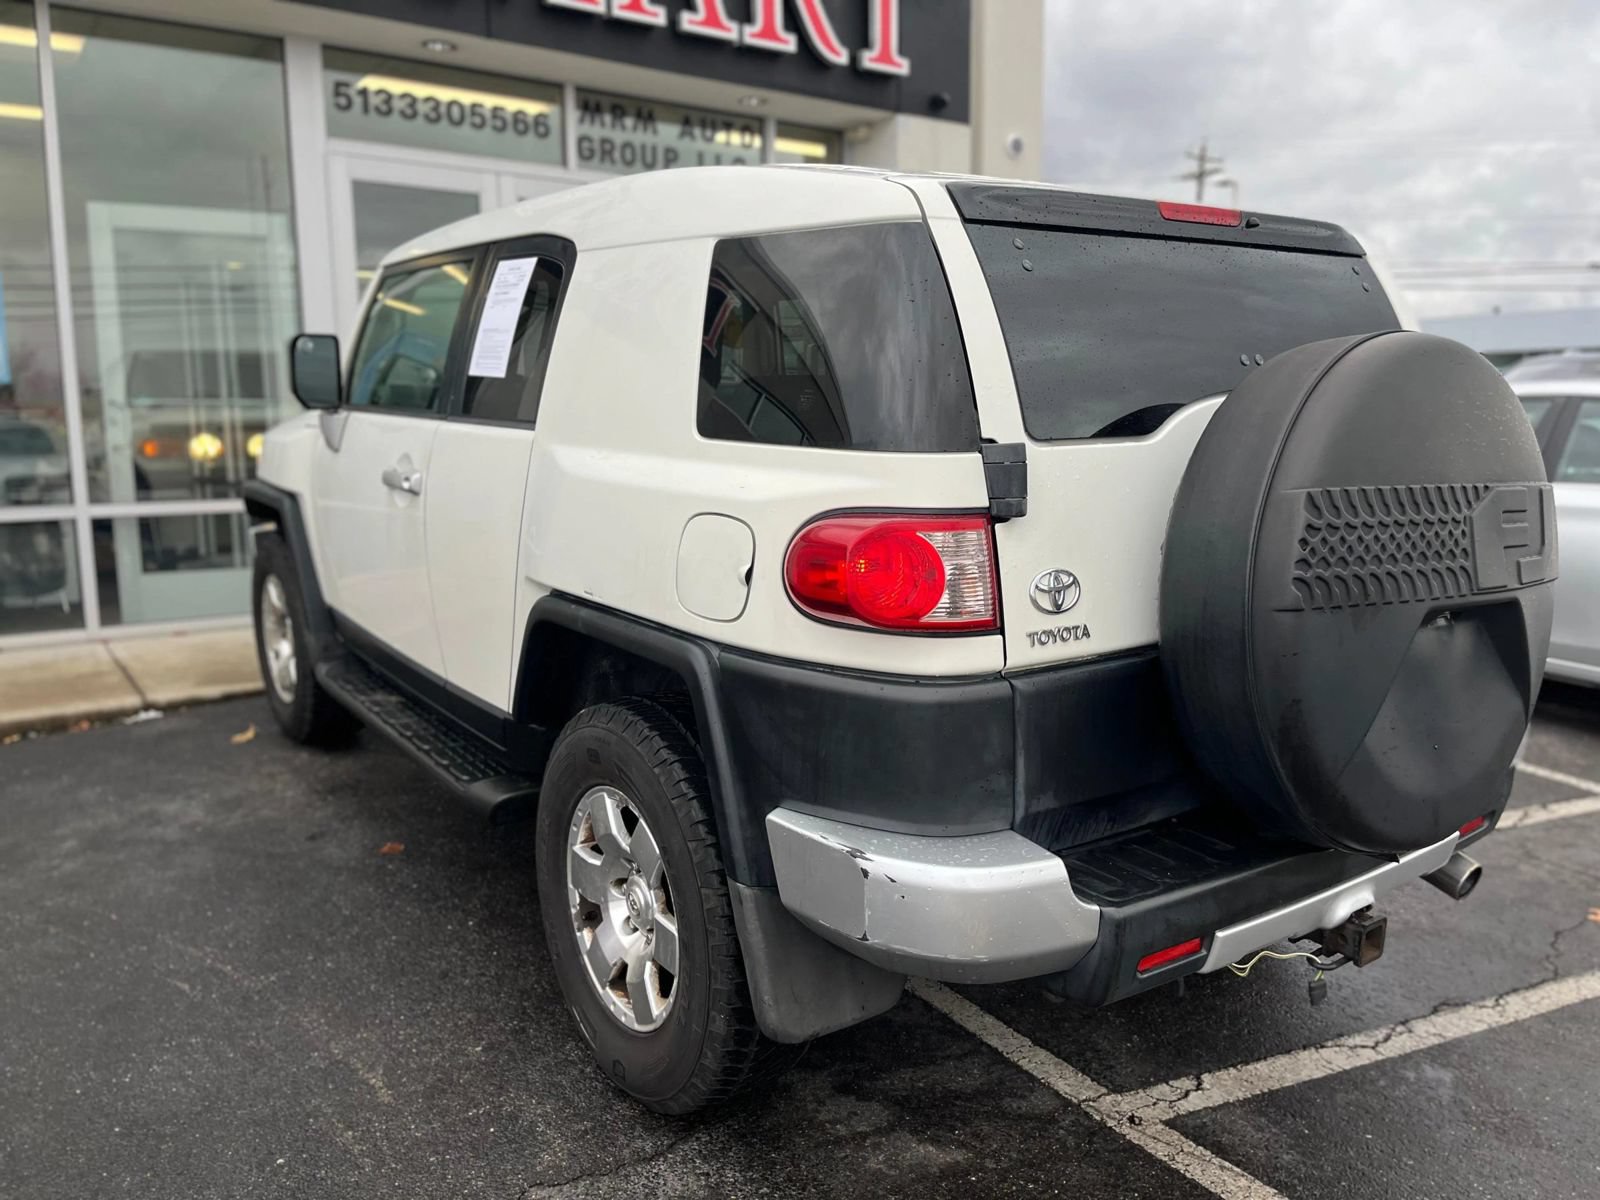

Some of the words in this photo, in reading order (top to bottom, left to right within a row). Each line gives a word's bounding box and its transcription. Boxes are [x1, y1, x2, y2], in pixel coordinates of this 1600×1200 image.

[332, 80, 552, 139] 5133305566
[578, 99, 660, 136] MRM
[678, 113, 763, 148] AUTO
[577, 134, 679, 170] GROUP
[1025, 623, 1091, 649] TOYOTA
